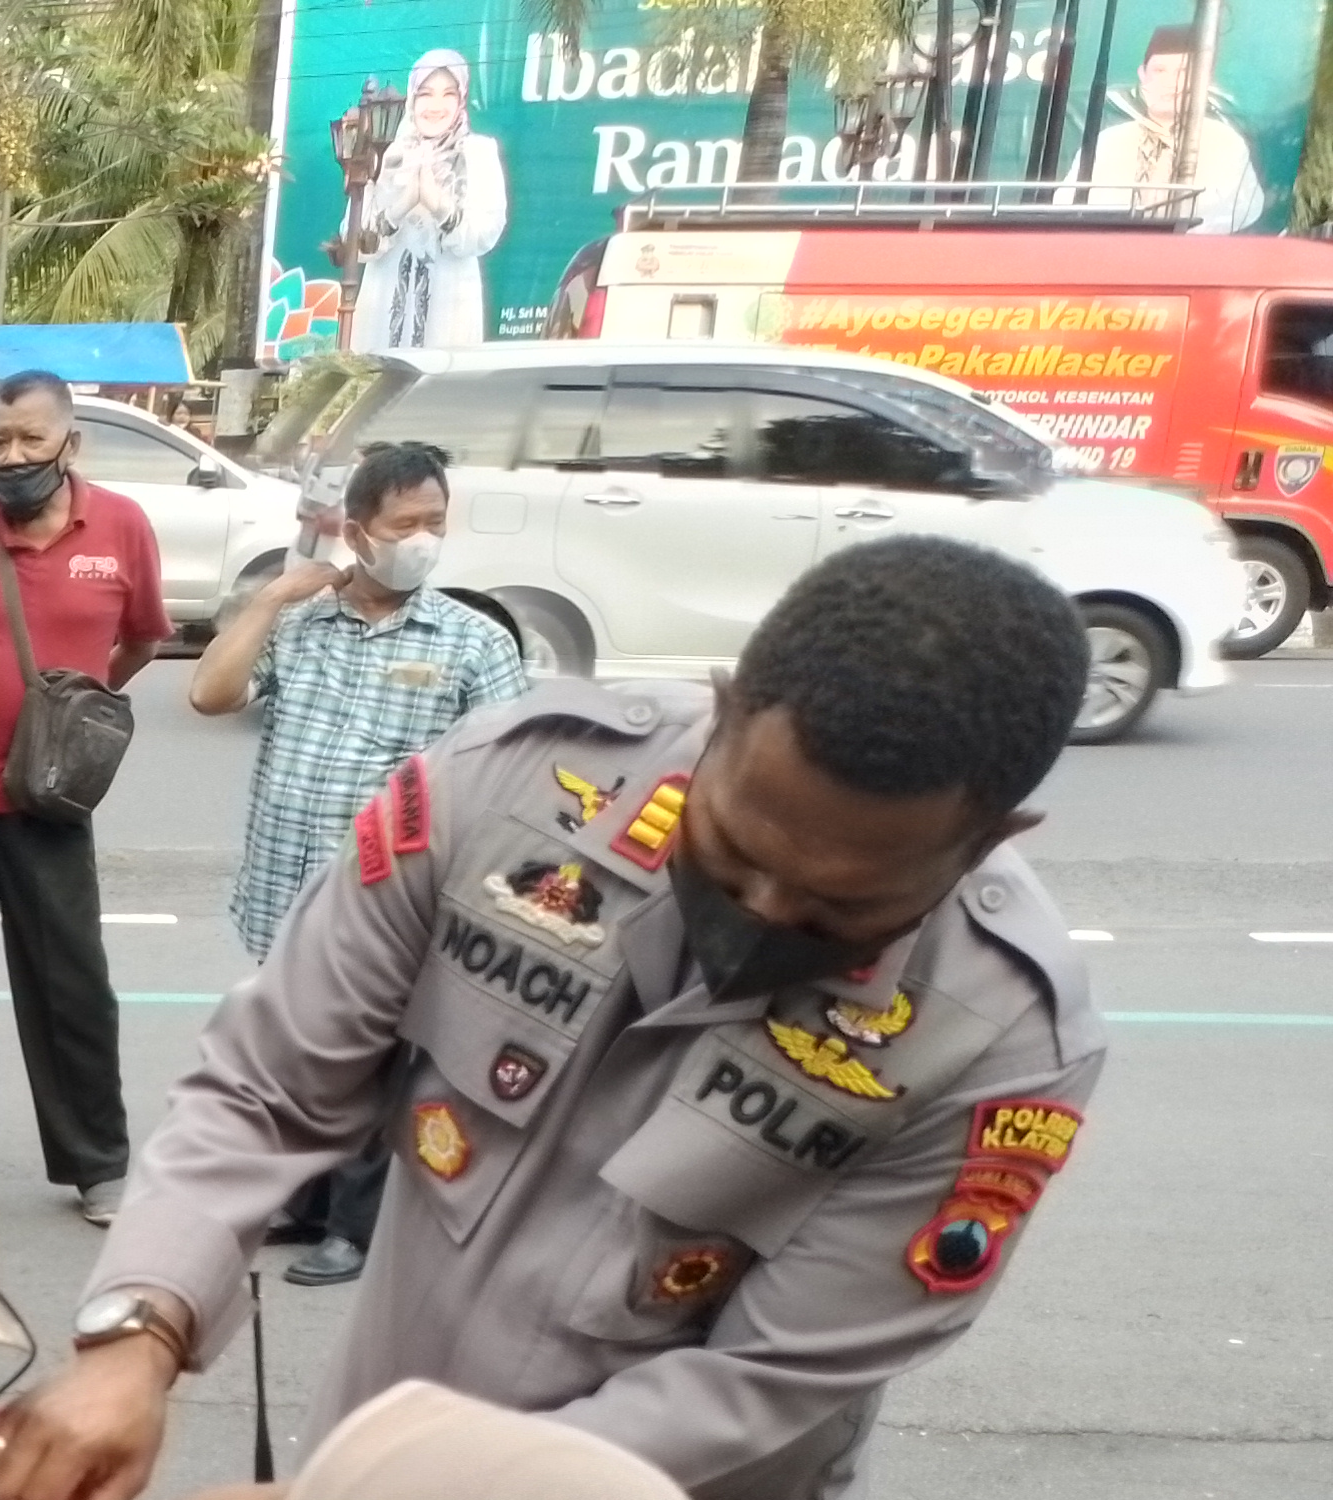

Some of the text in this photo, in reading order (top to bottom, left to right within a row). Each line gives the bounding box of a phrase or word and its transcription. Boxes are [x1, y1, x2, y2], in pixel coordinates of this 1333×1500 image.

[798, 299, 1169, 336] #AyoSegeraVaksin
[1053, 391, 1155, 406] KESEHATAN
[1109, 446, 1137, 471] 19
[442, 912, 591, 1024] NOACH
[695, 1058, 868, 1170] POLRI
